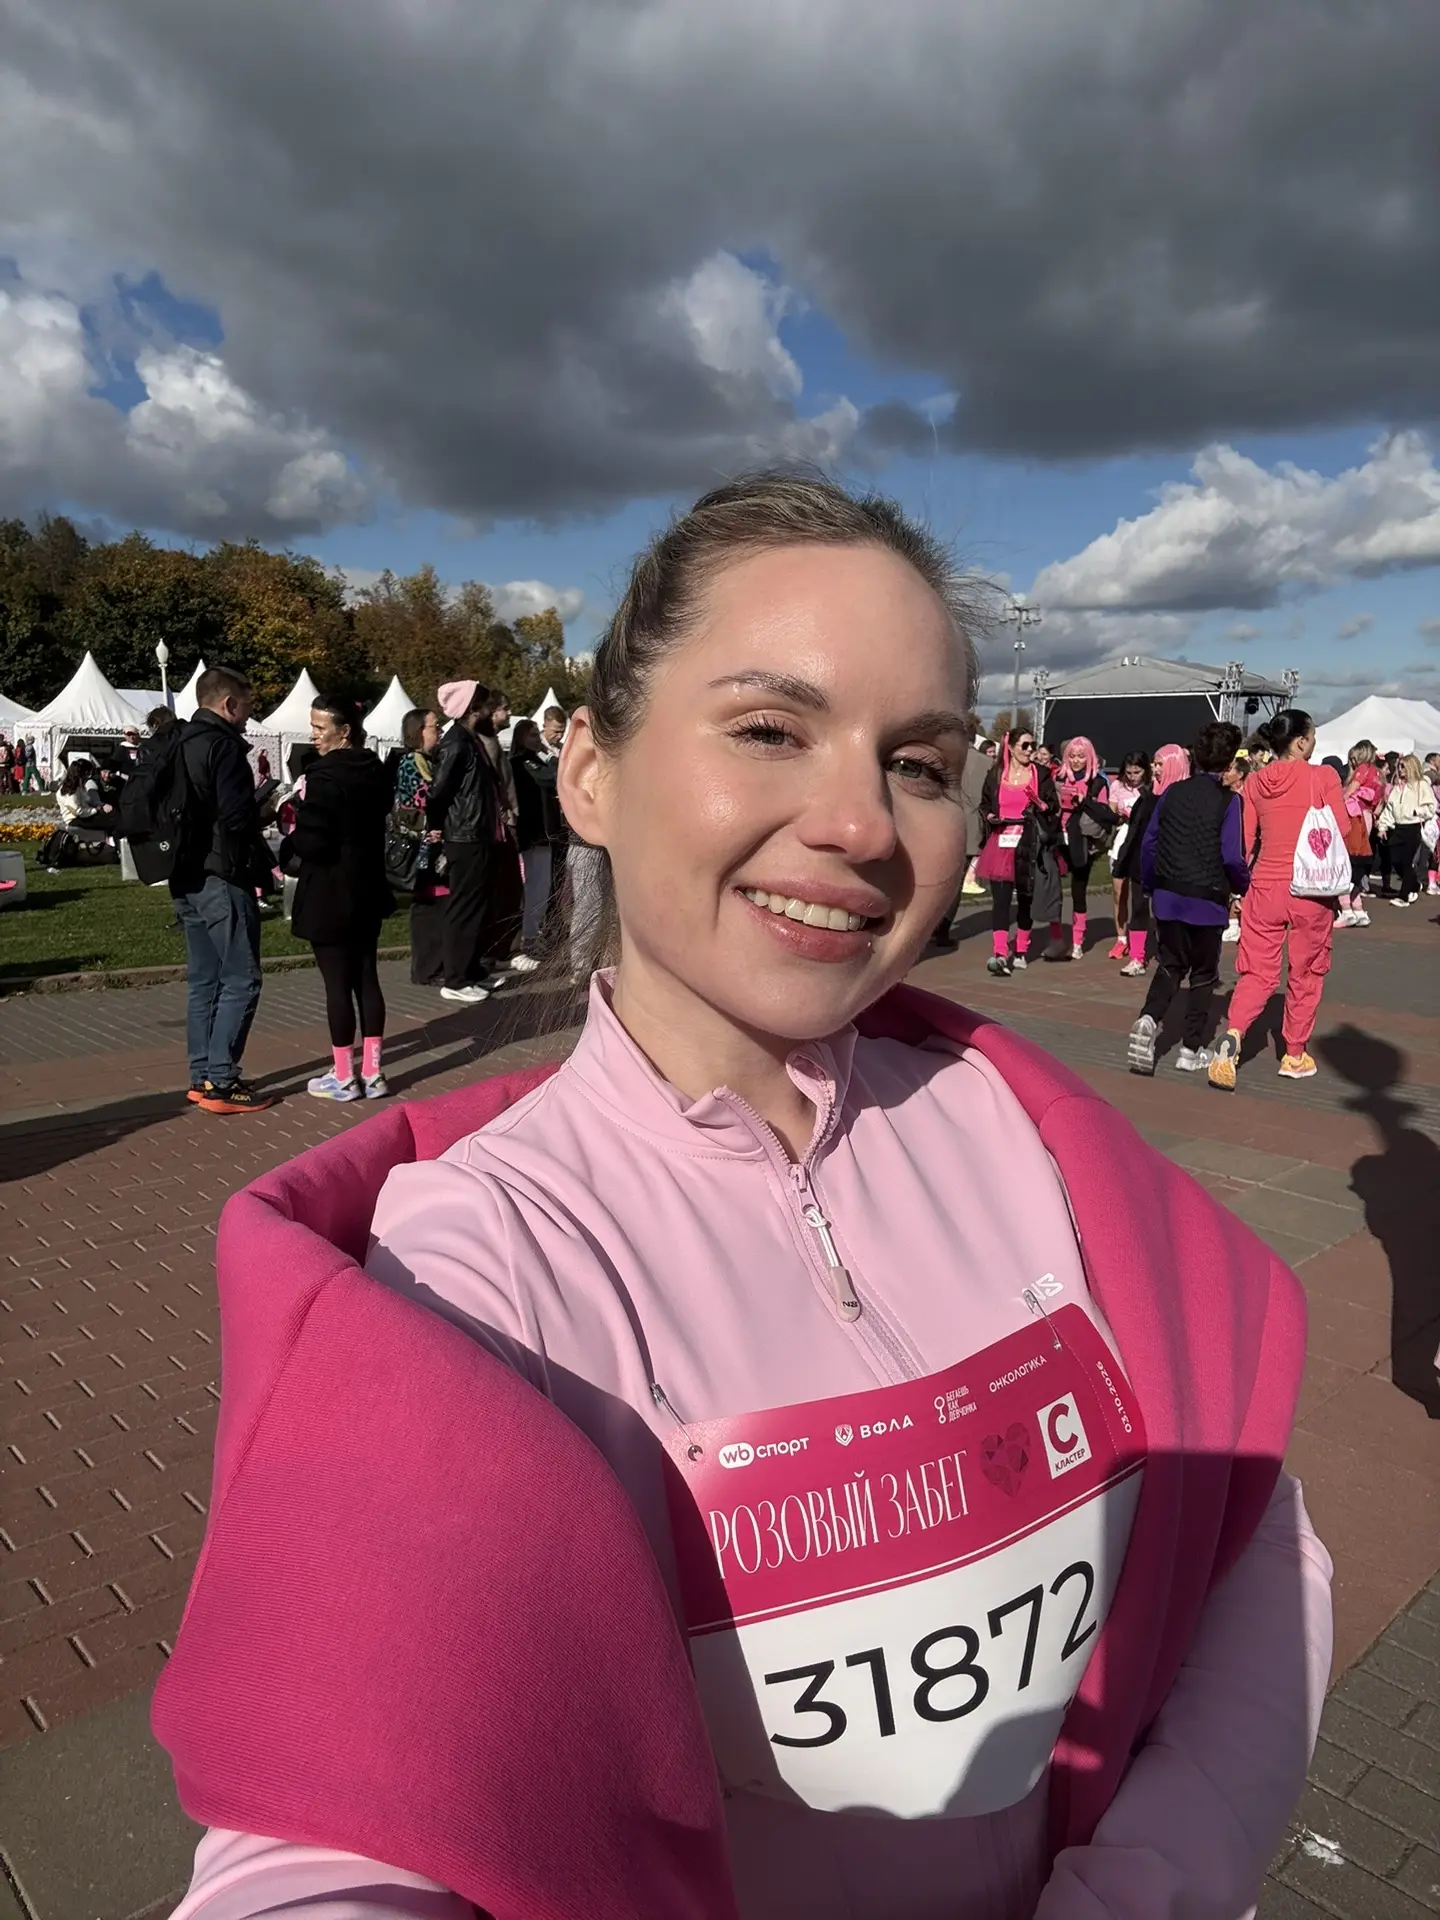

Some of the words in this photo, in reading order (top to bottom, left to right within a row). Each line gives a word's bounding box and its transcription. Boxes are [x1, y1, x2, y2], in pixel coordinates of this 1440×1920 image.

[989, 1354, 1047, 1393] ОНКОЛОГИКА
[1096, 1361, 1132, 1433] 03.10.2026
[859, 1414, 914, 1438] ВФЛА
[1055, 1448, 1086, 1471] КЛАСТЕР
[708, 1469, 879, 1580] РОЗОВЫЙ
[880, 1449, 969, 1539] ЗАБЕГ
[764, 1560, 1097, 1748] 31872
